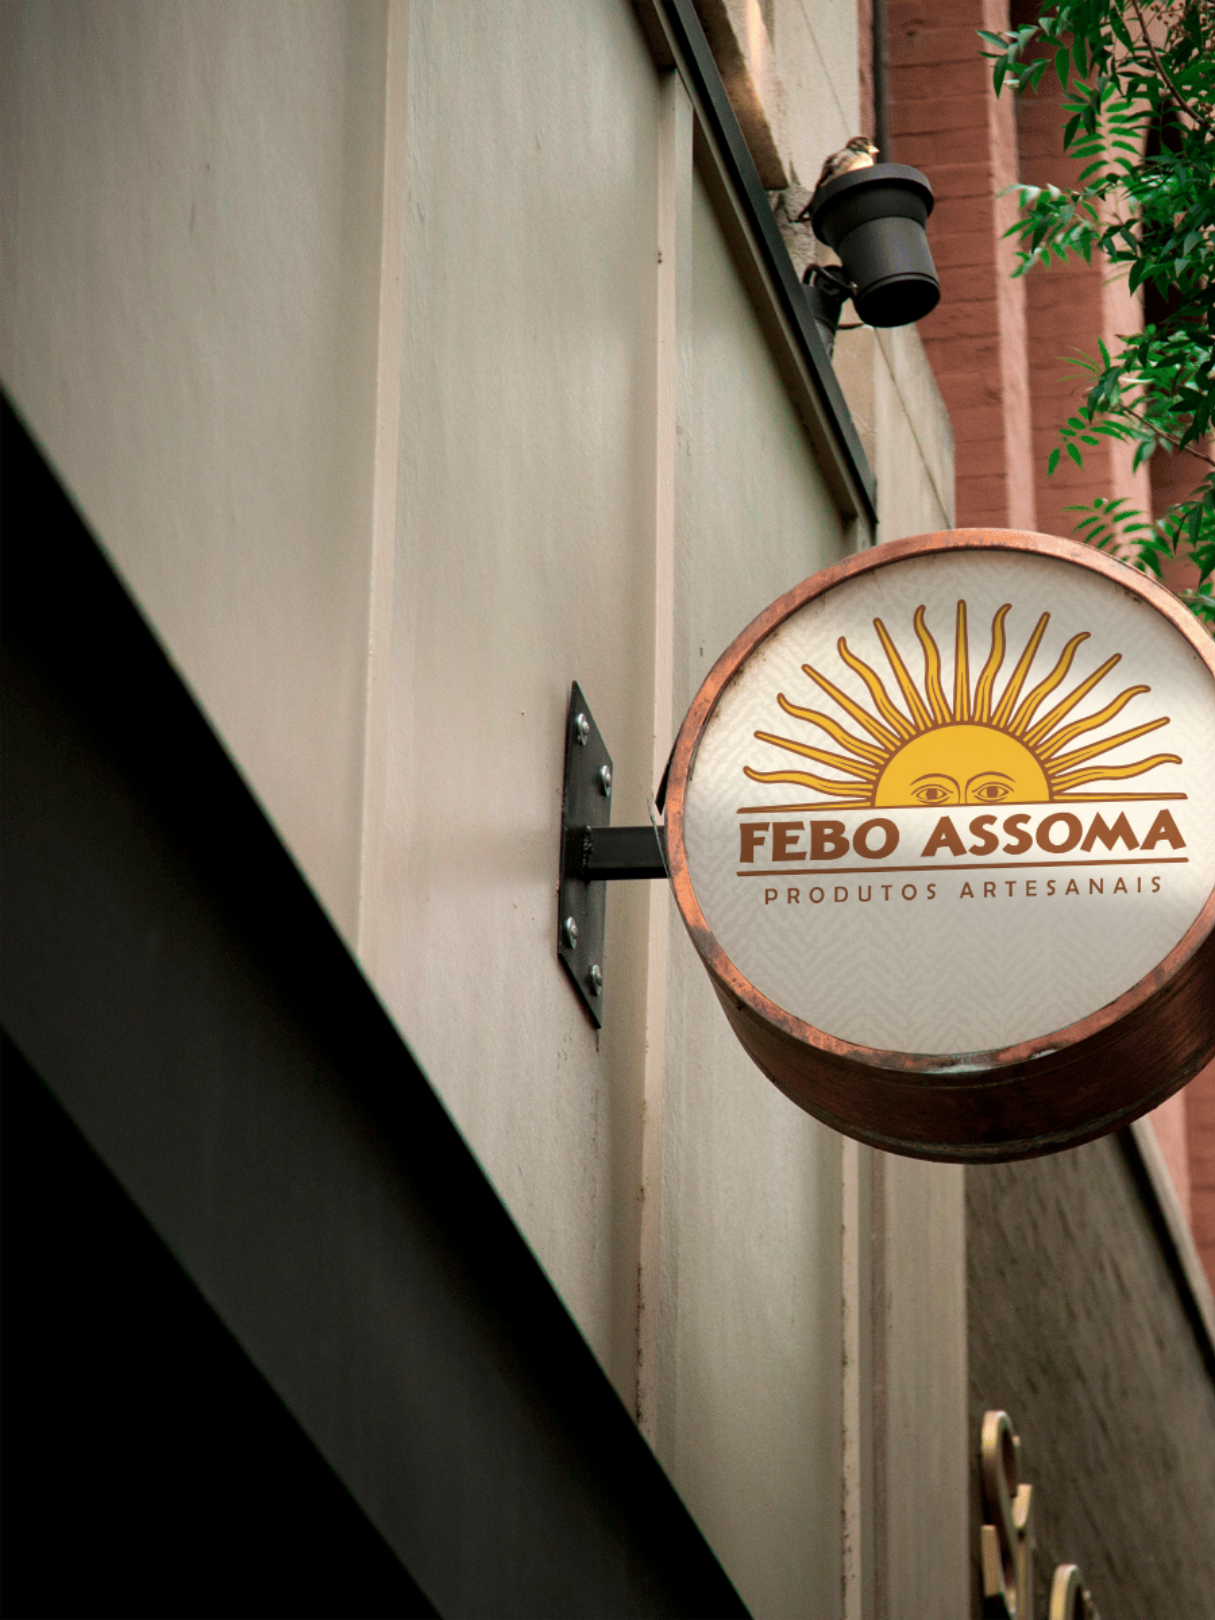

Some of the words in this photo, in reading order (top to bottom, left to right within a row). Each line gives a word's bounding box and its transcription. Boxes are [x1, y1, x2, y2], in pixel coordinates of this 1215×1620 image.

[739, 817, 900, 864] FEBO
[920, 809, 1187, 858] ASSOMA
[764, 883, 938, 905] PRODUTOS
[959, 876, 1162, 899] ARTESANAIS
